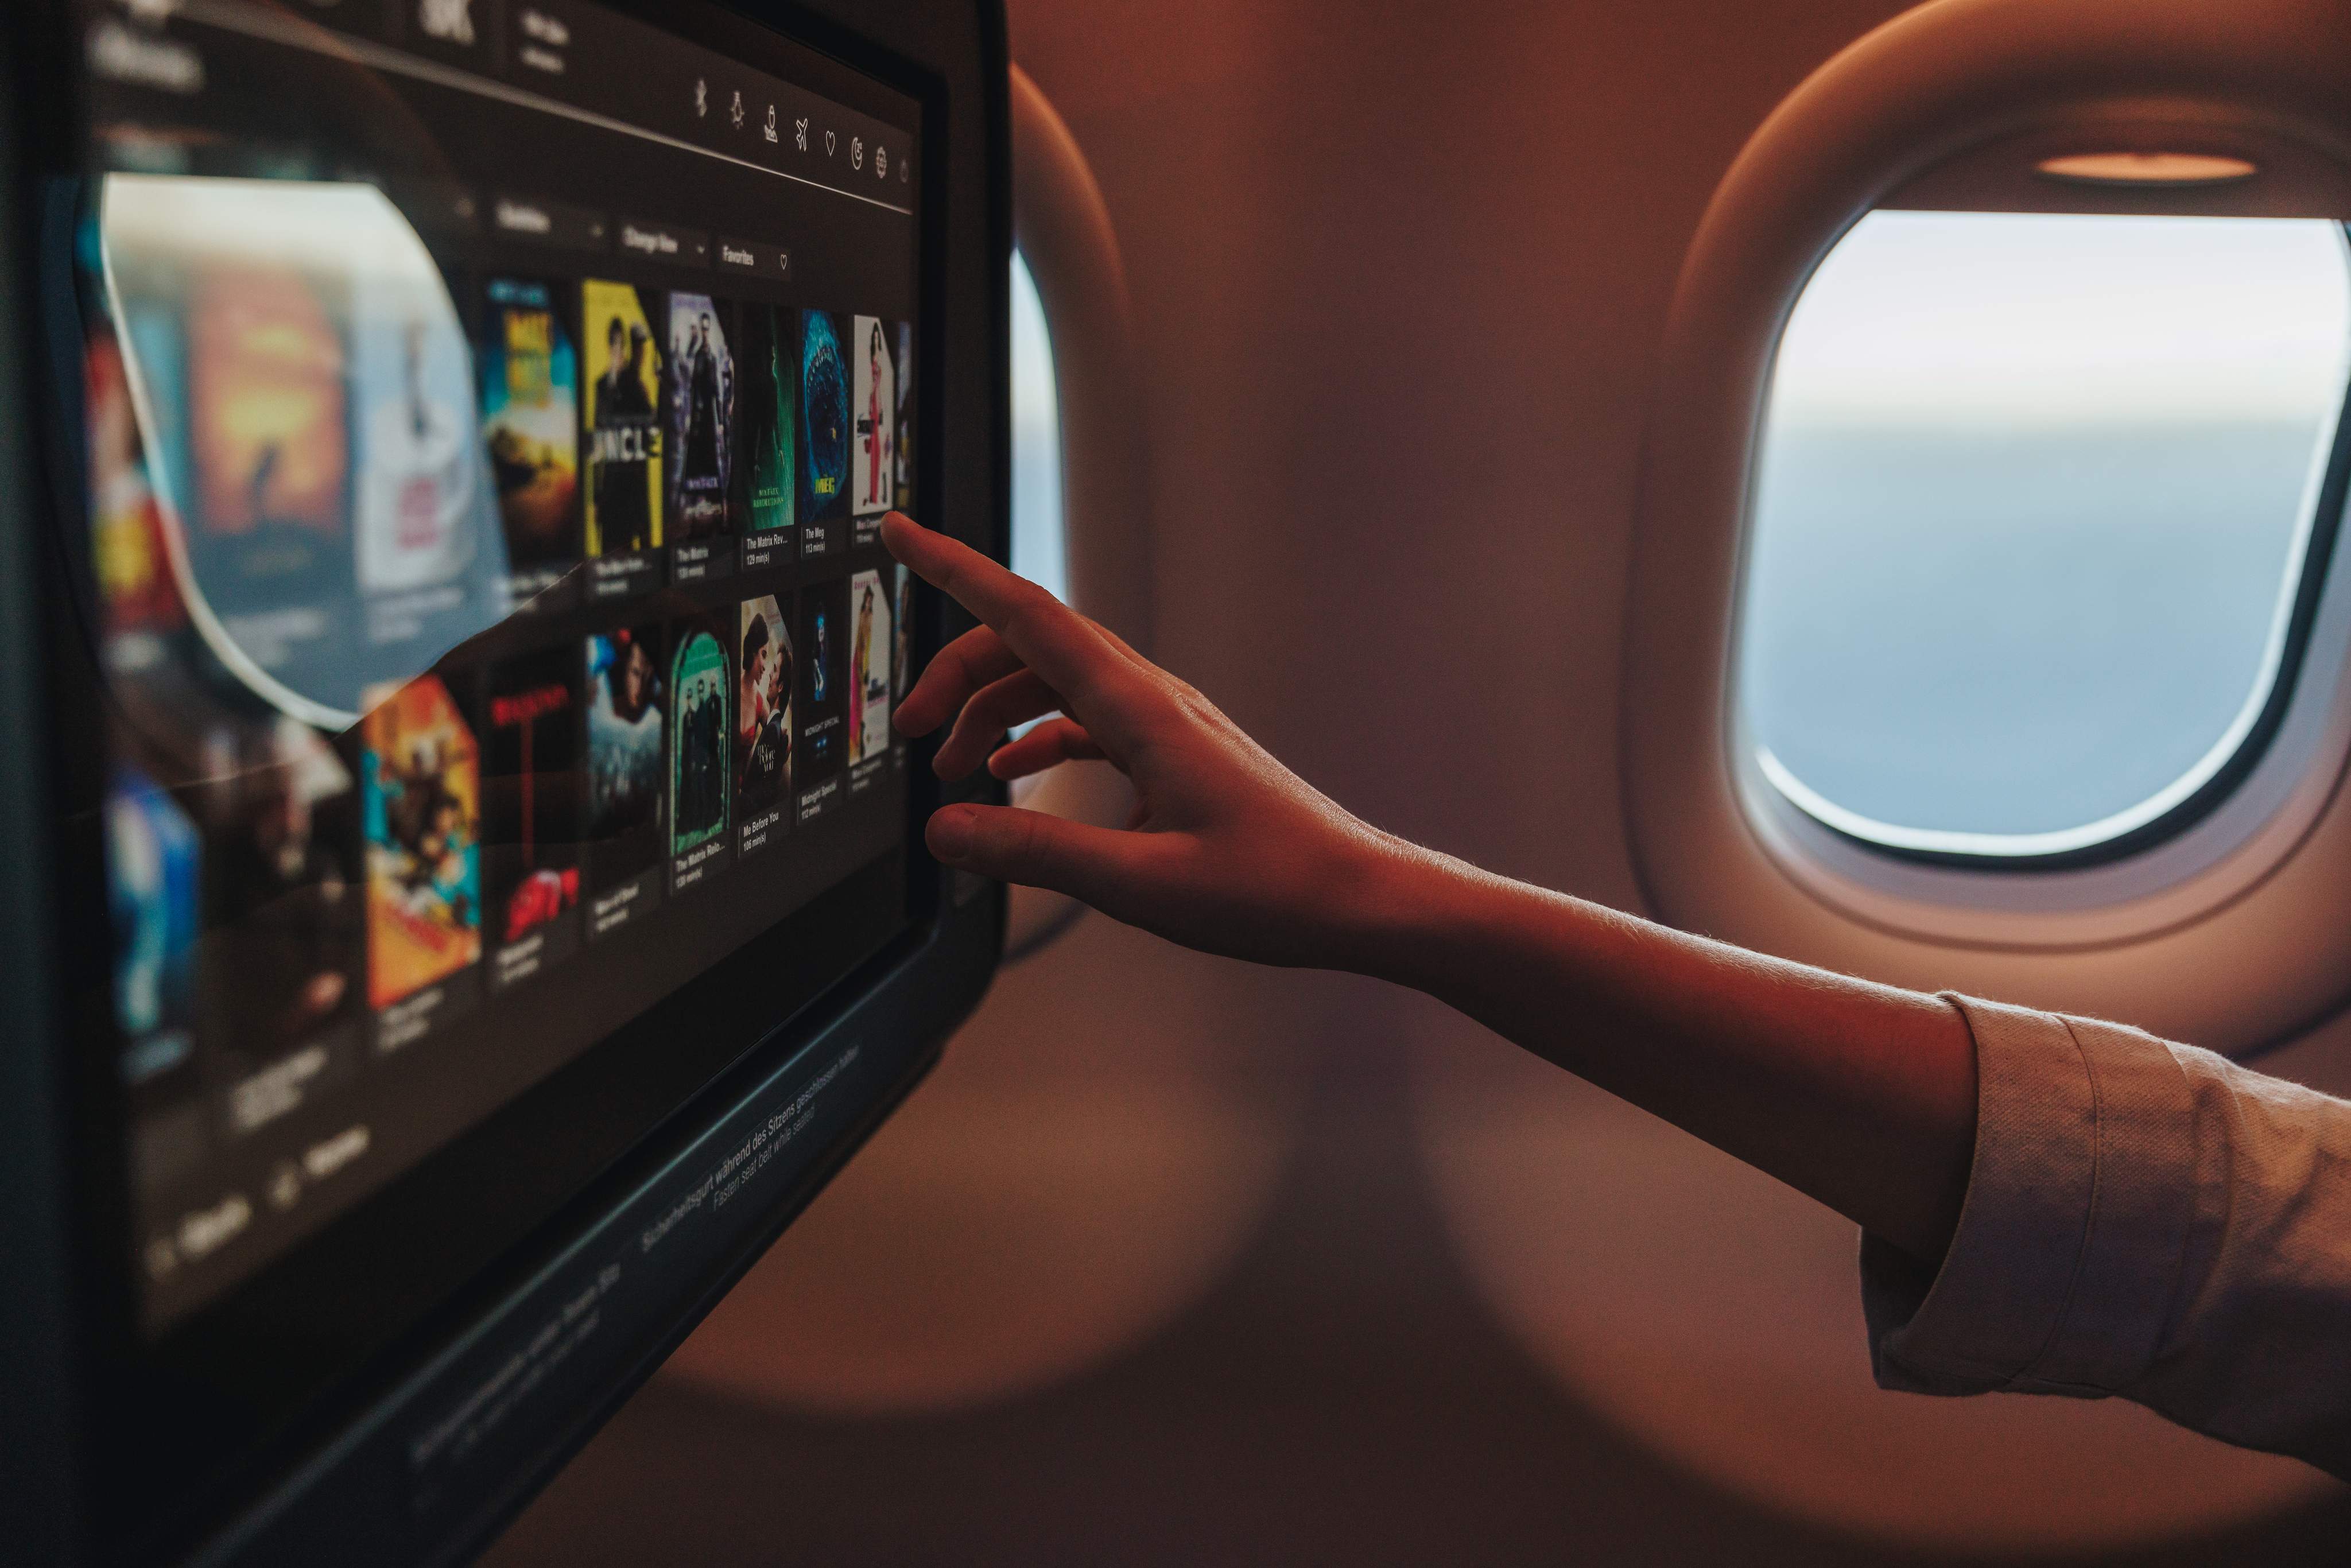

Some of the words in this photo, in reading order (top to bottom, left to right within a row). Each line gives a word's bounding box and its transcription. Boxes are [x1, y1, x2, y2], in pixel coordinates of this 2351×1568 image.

[723, 245, 754, 266] Favorites
[815, 477, 835, 495] MEG
[747, 538, 756, 550] The
[757, 534, 773, 548] Matrix
[806, 528, 814, 540] The
[814, 526, 825, 540] Meg
[813, 541, 825, 554] min(s)
[747, 553, 756, 566] 129
[756, 551, 770, 565] min(s)
[802, 808, 810, 821] 112
[743, 825, 751, 838] Me
[752, 816, 769, 832] Before
[769, 811, 779, 824] You
[743, 839, 752, 852] 106
[752, 831, 766, 847] min(s)
[715, 1139, 751, 1185] während
[752, 1129, 767, 1151] des
[768, 1105, 796, 1137] Sitzens
[796, 1064, 839, 1113] geschlossen
[713, 1177, 740, 1212] Fasten
[741, 1158, 757, 1184] seat
[758, 1146, 773, 1167] belt
[773, 1130, 792, 1154] while
[792, 1102, 816, 1136] seated
